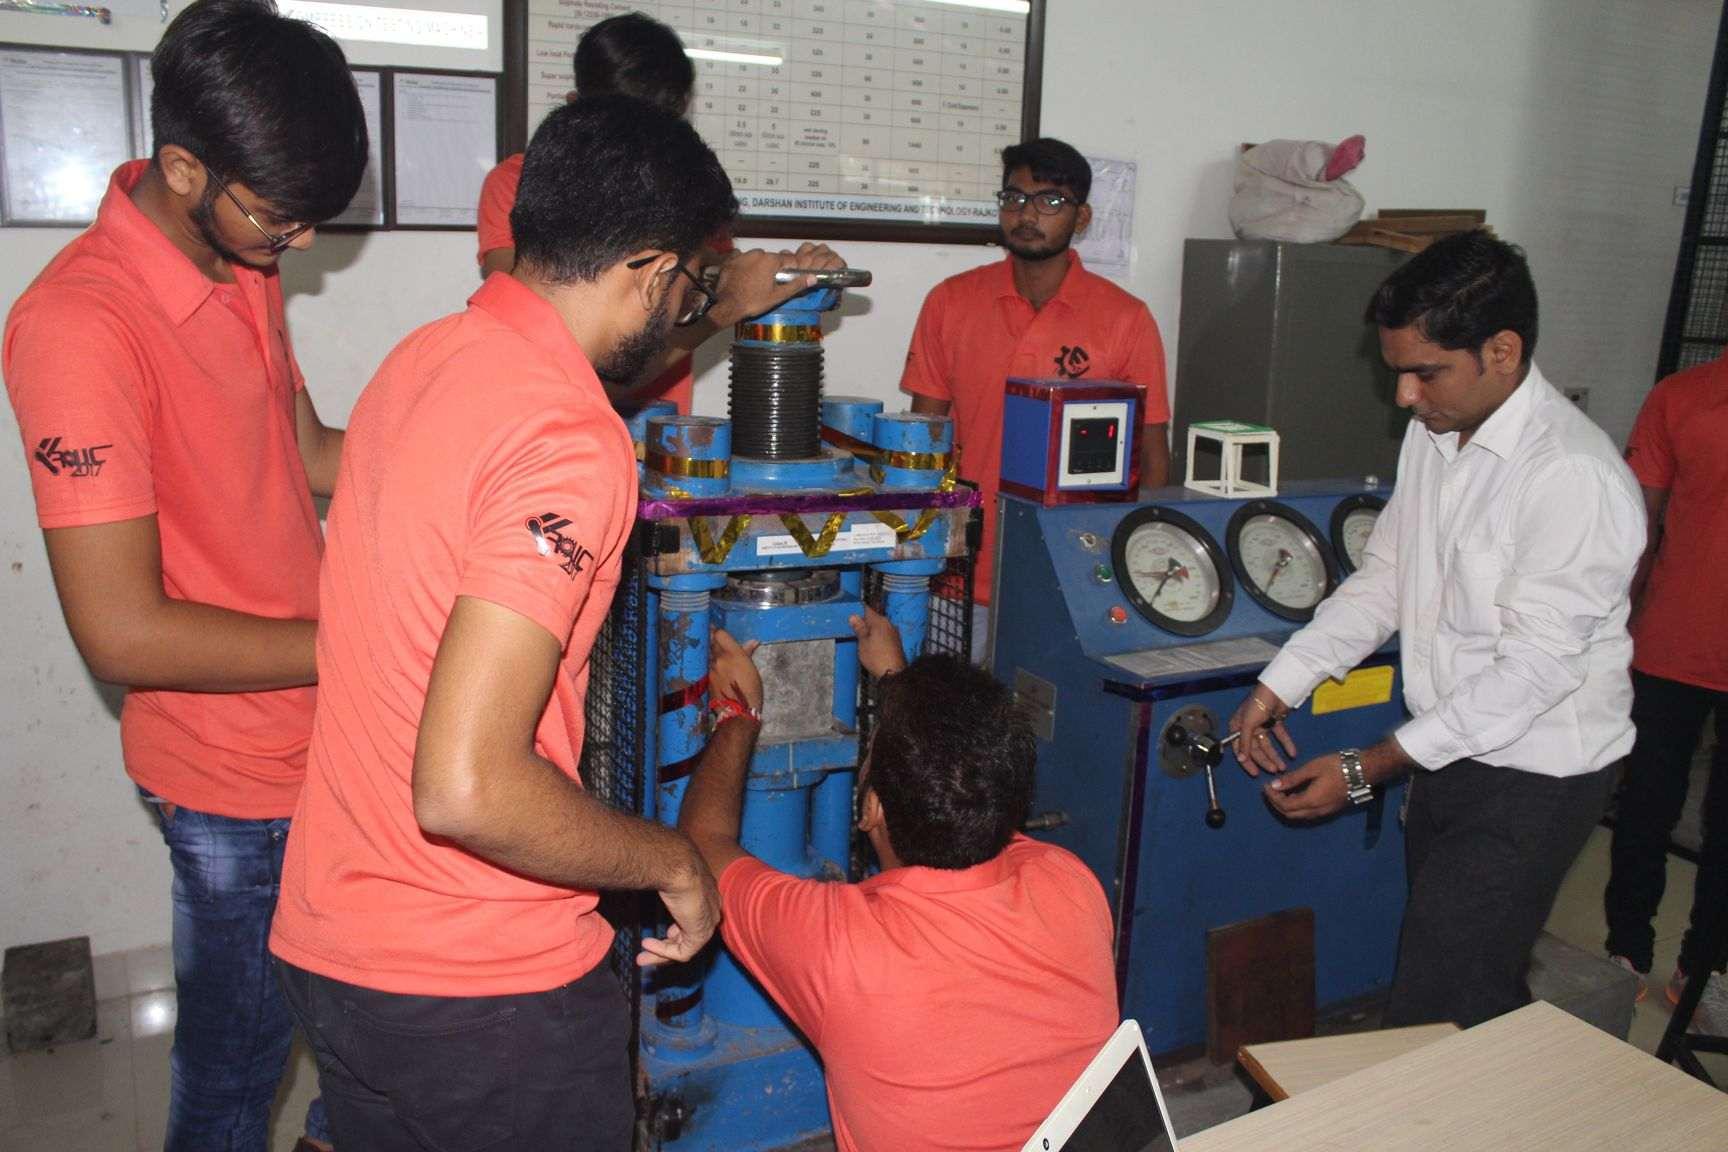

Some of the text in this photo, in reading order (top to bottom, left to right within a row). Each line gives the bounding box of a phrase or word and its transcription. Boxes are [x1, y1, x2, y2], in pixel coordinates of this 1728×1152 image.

[752, 197, 793, 209] DARSHAN
[794, 199, 835, 211] INSTITUTE
[836, 201, 848, 211] OF
[849, 201, 902, 213] ENGINEERING
[903, 204, 919, 214] AND
